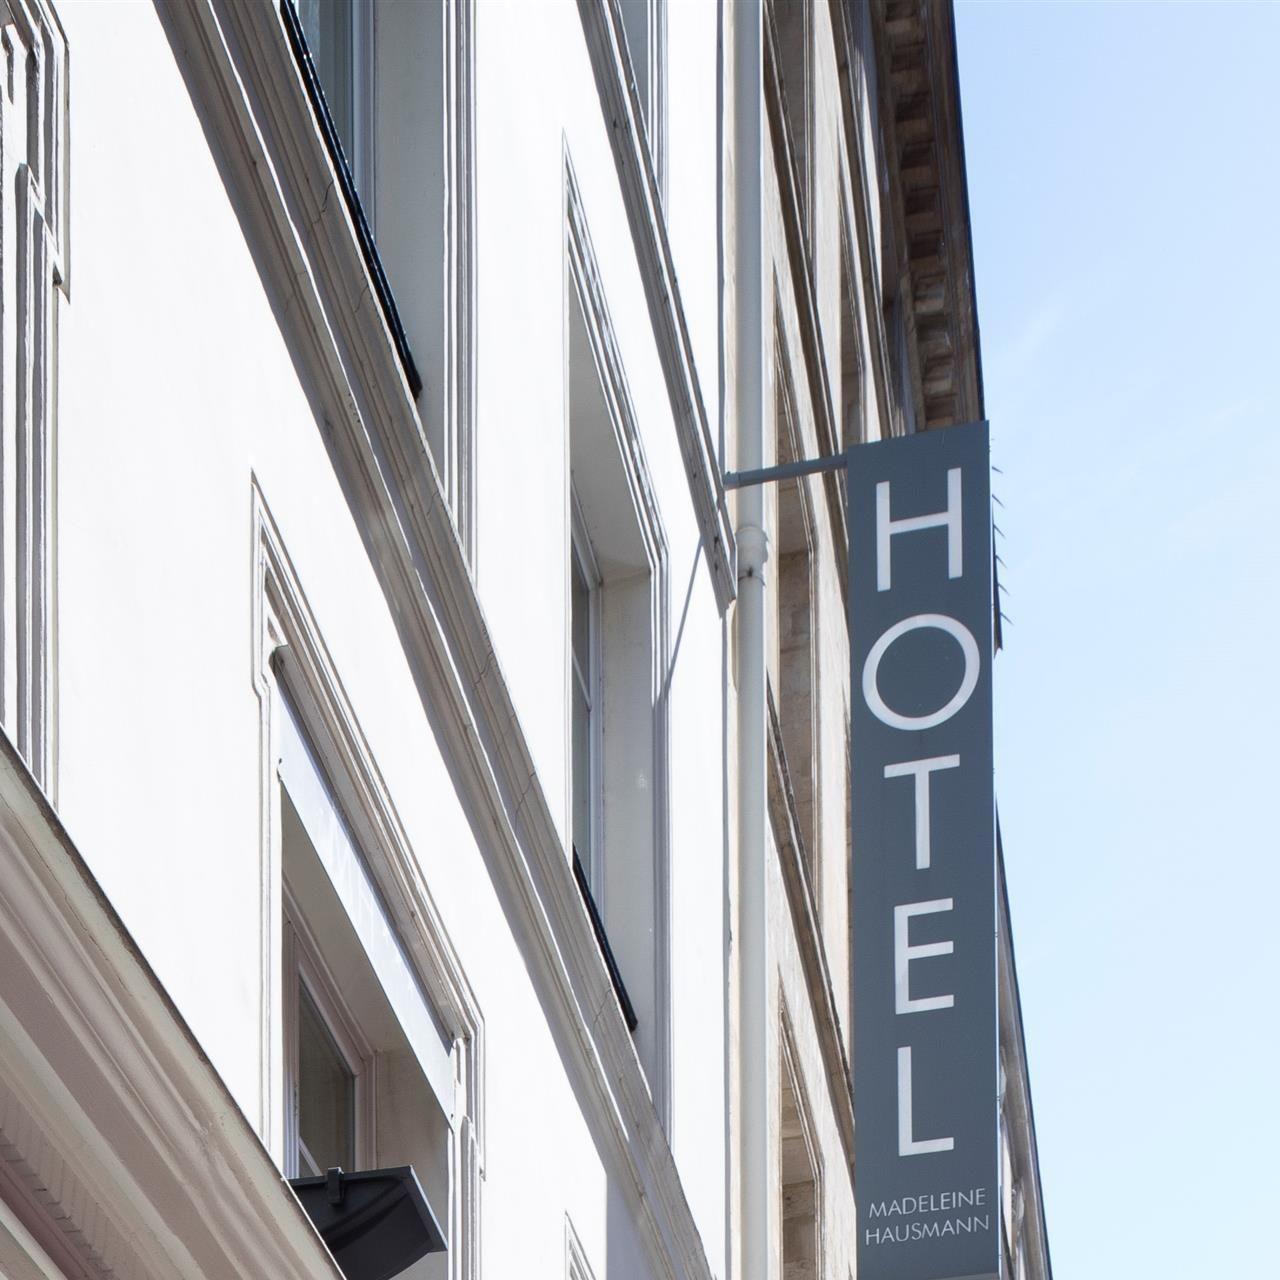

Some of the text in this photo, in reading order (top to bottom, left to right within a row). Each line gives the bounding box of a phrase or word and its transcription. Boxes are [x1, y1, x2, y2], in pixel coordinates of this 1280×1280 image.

[862, 467, 980, 1157] HOTEL
[869, 1188, 986, 1219] MADELEINE
[865, 1214, 989, 1246] HAUSMANN
